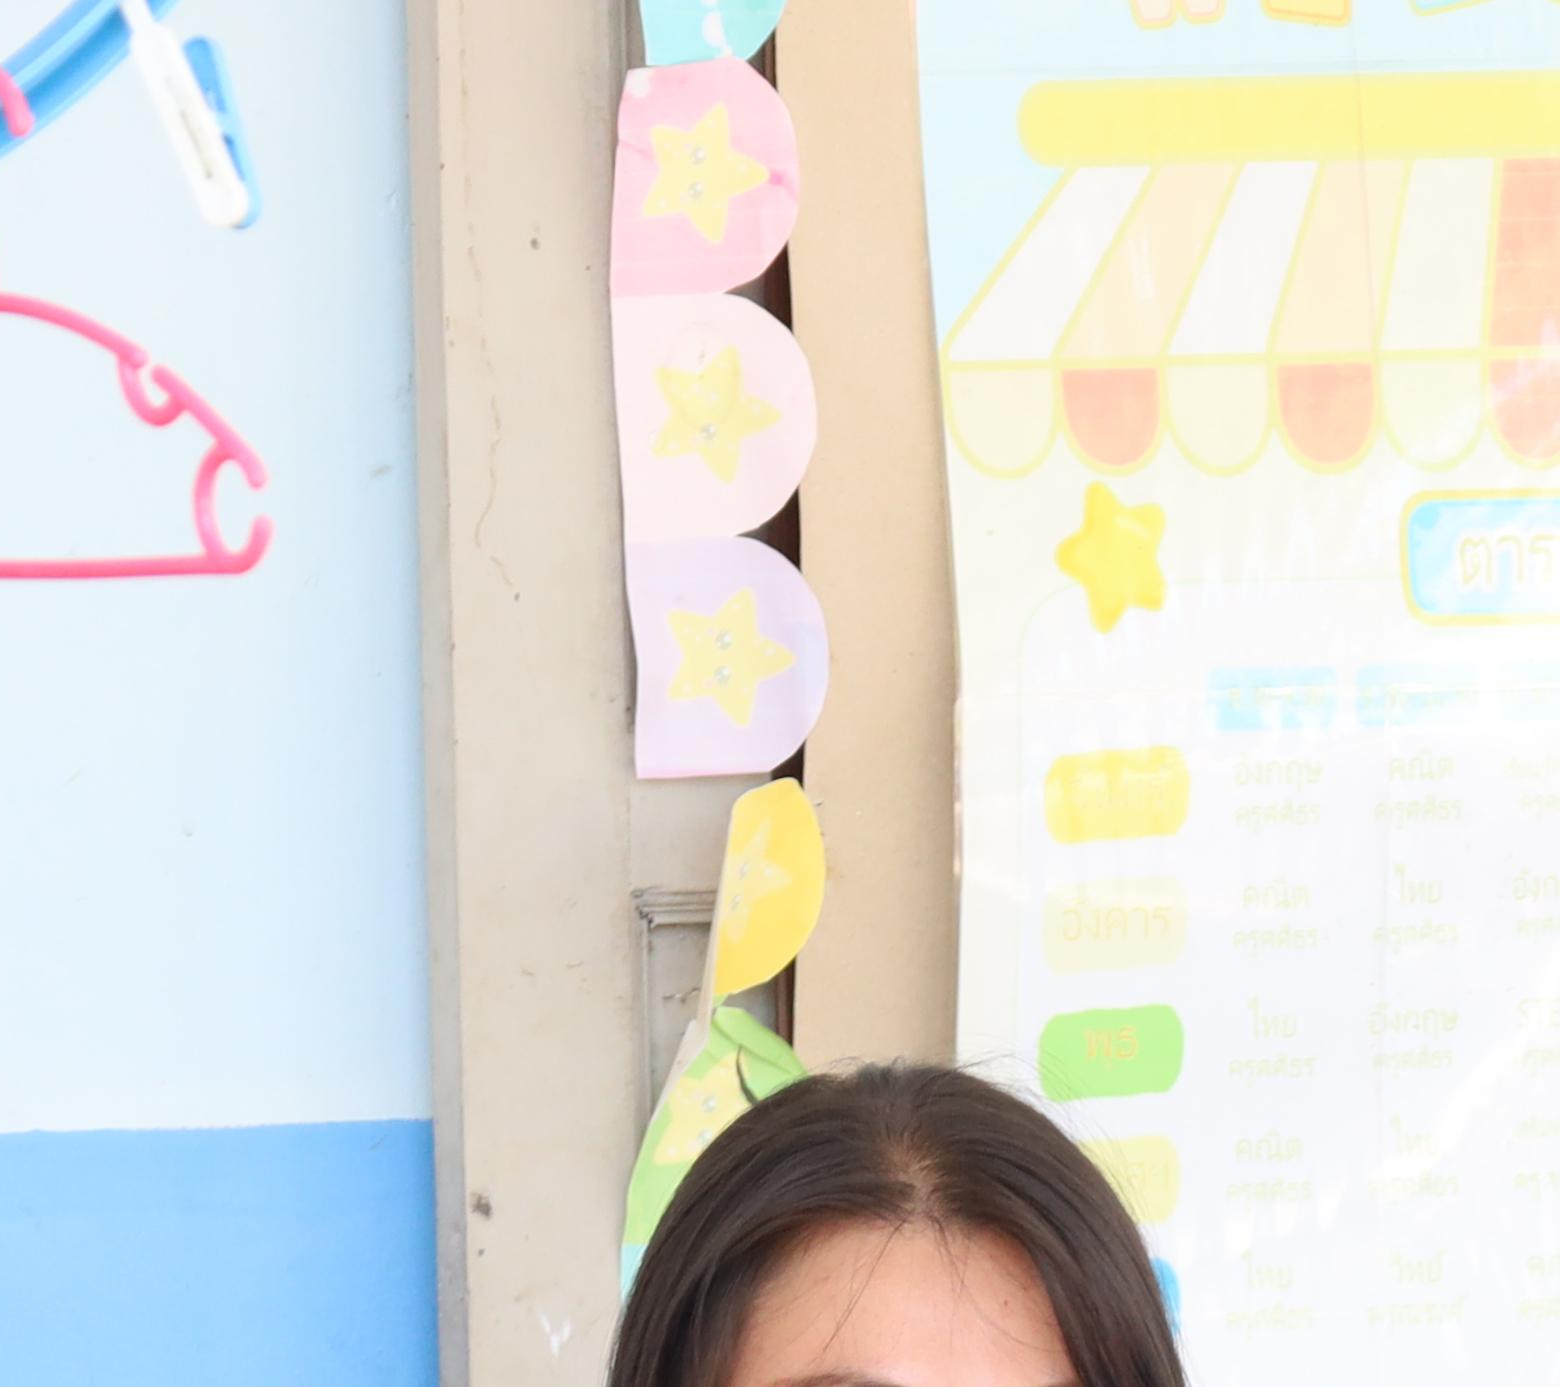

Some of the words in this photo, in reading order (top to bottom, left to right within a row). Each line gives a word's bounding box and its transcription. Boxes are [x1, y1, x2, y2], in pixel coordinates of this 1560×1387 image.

[1232, 749, 1325, 792] อังกฤษ
[1386, 744, 1457, 784] คณิต
[1240, 870, 1313, 911] คณิต
[1392, 862, 1445, 904] ไทย
[1060, 886, 1173, 945] อังคาร
[1245, 995, 1299, 1040] ไทย
[1368, 998, 1462, 1038] อังกฤษ
[1083, 1024, 1140, 1072] พุธ
[1232, 1127, 1304, 1163] คณิต
[1240, 1247, 1297, 1293] ไทย
